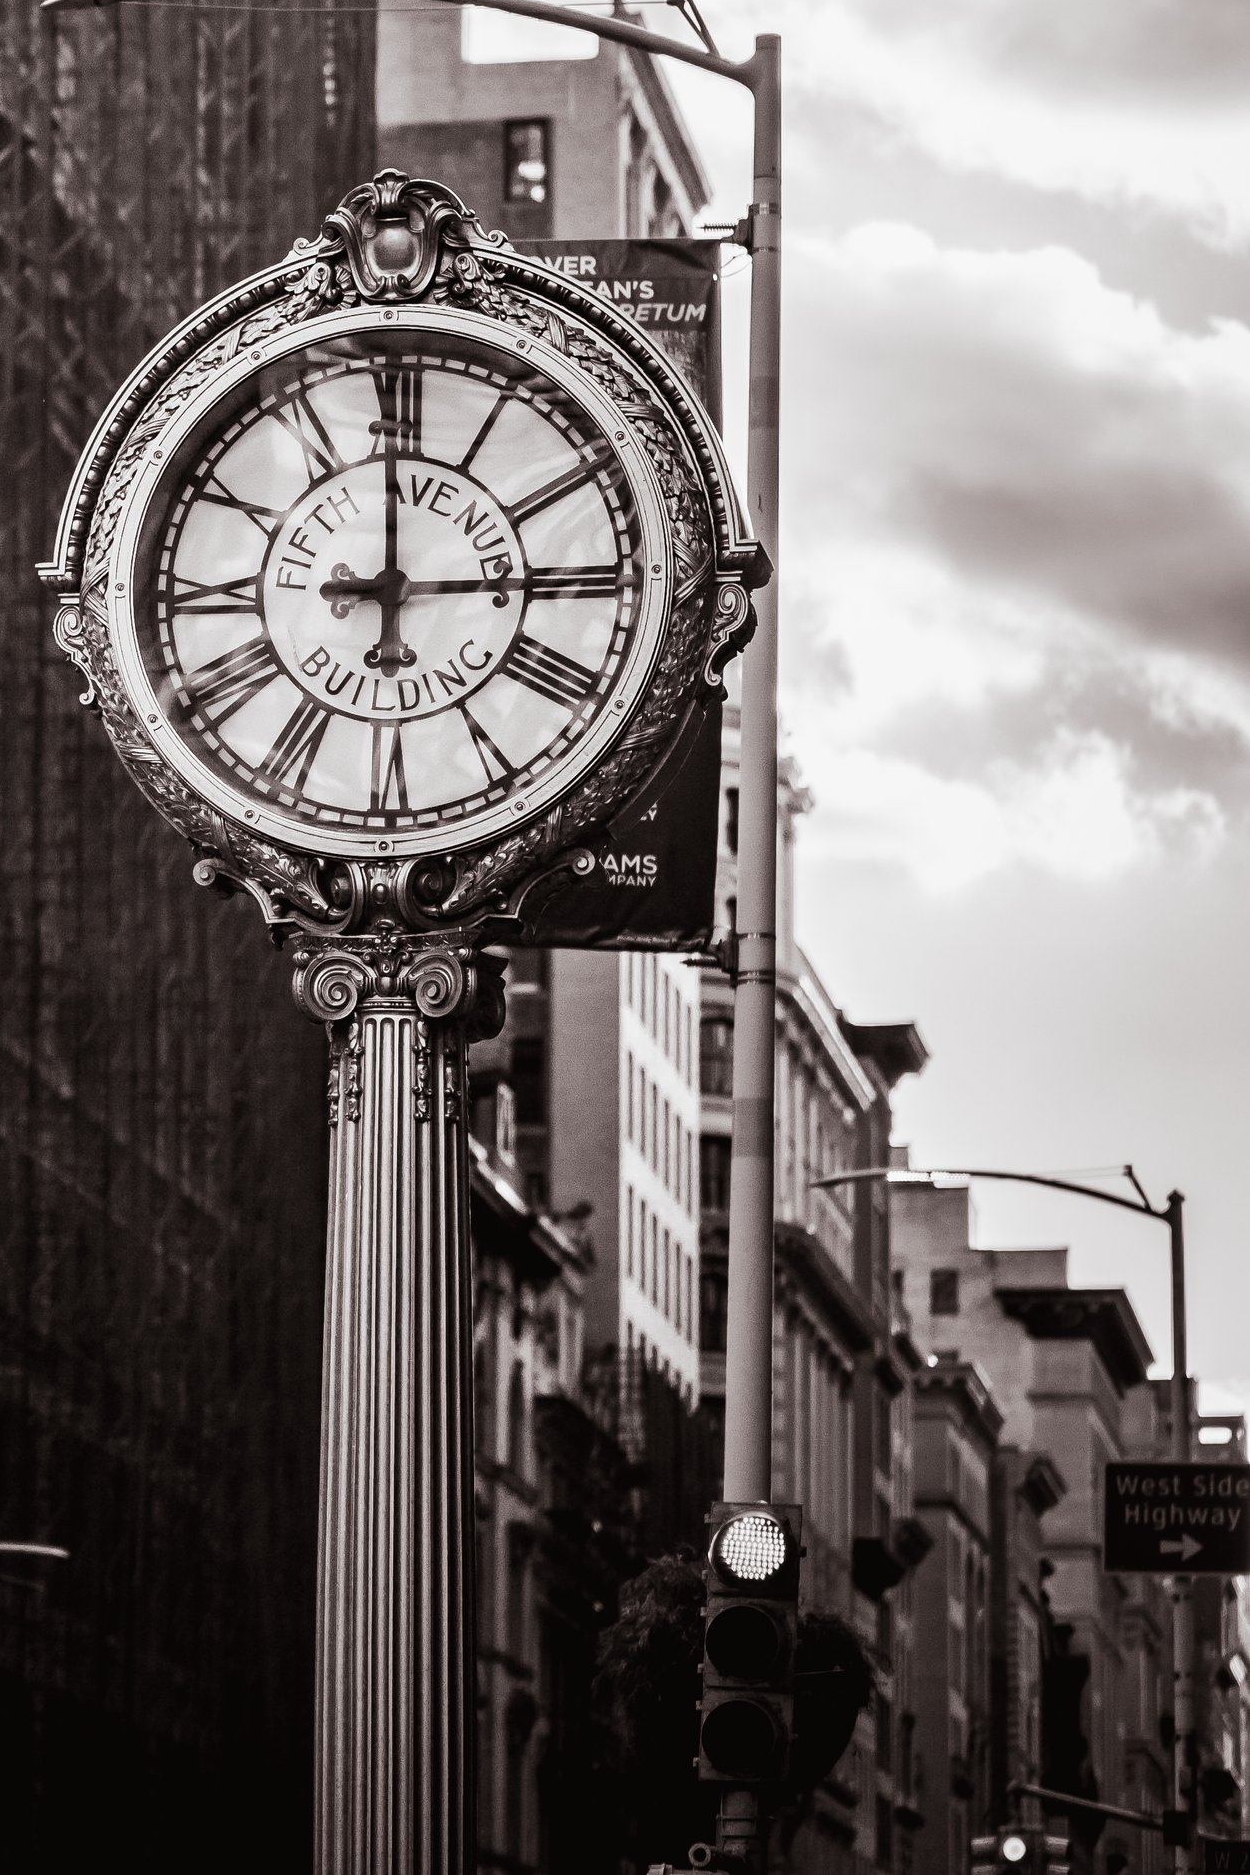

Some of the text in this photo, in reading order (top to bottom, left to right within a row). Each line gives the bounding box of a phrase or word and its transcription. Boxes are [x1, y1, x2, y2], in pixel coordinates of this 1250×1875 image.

[276, 474, 513, 590] FIFTH AVENUE
[300, 638, 493, 712] BUILDING
[1116, 1473, 1250, 1497] West Side
[1125, 1502, 1241, 1532] Highway
